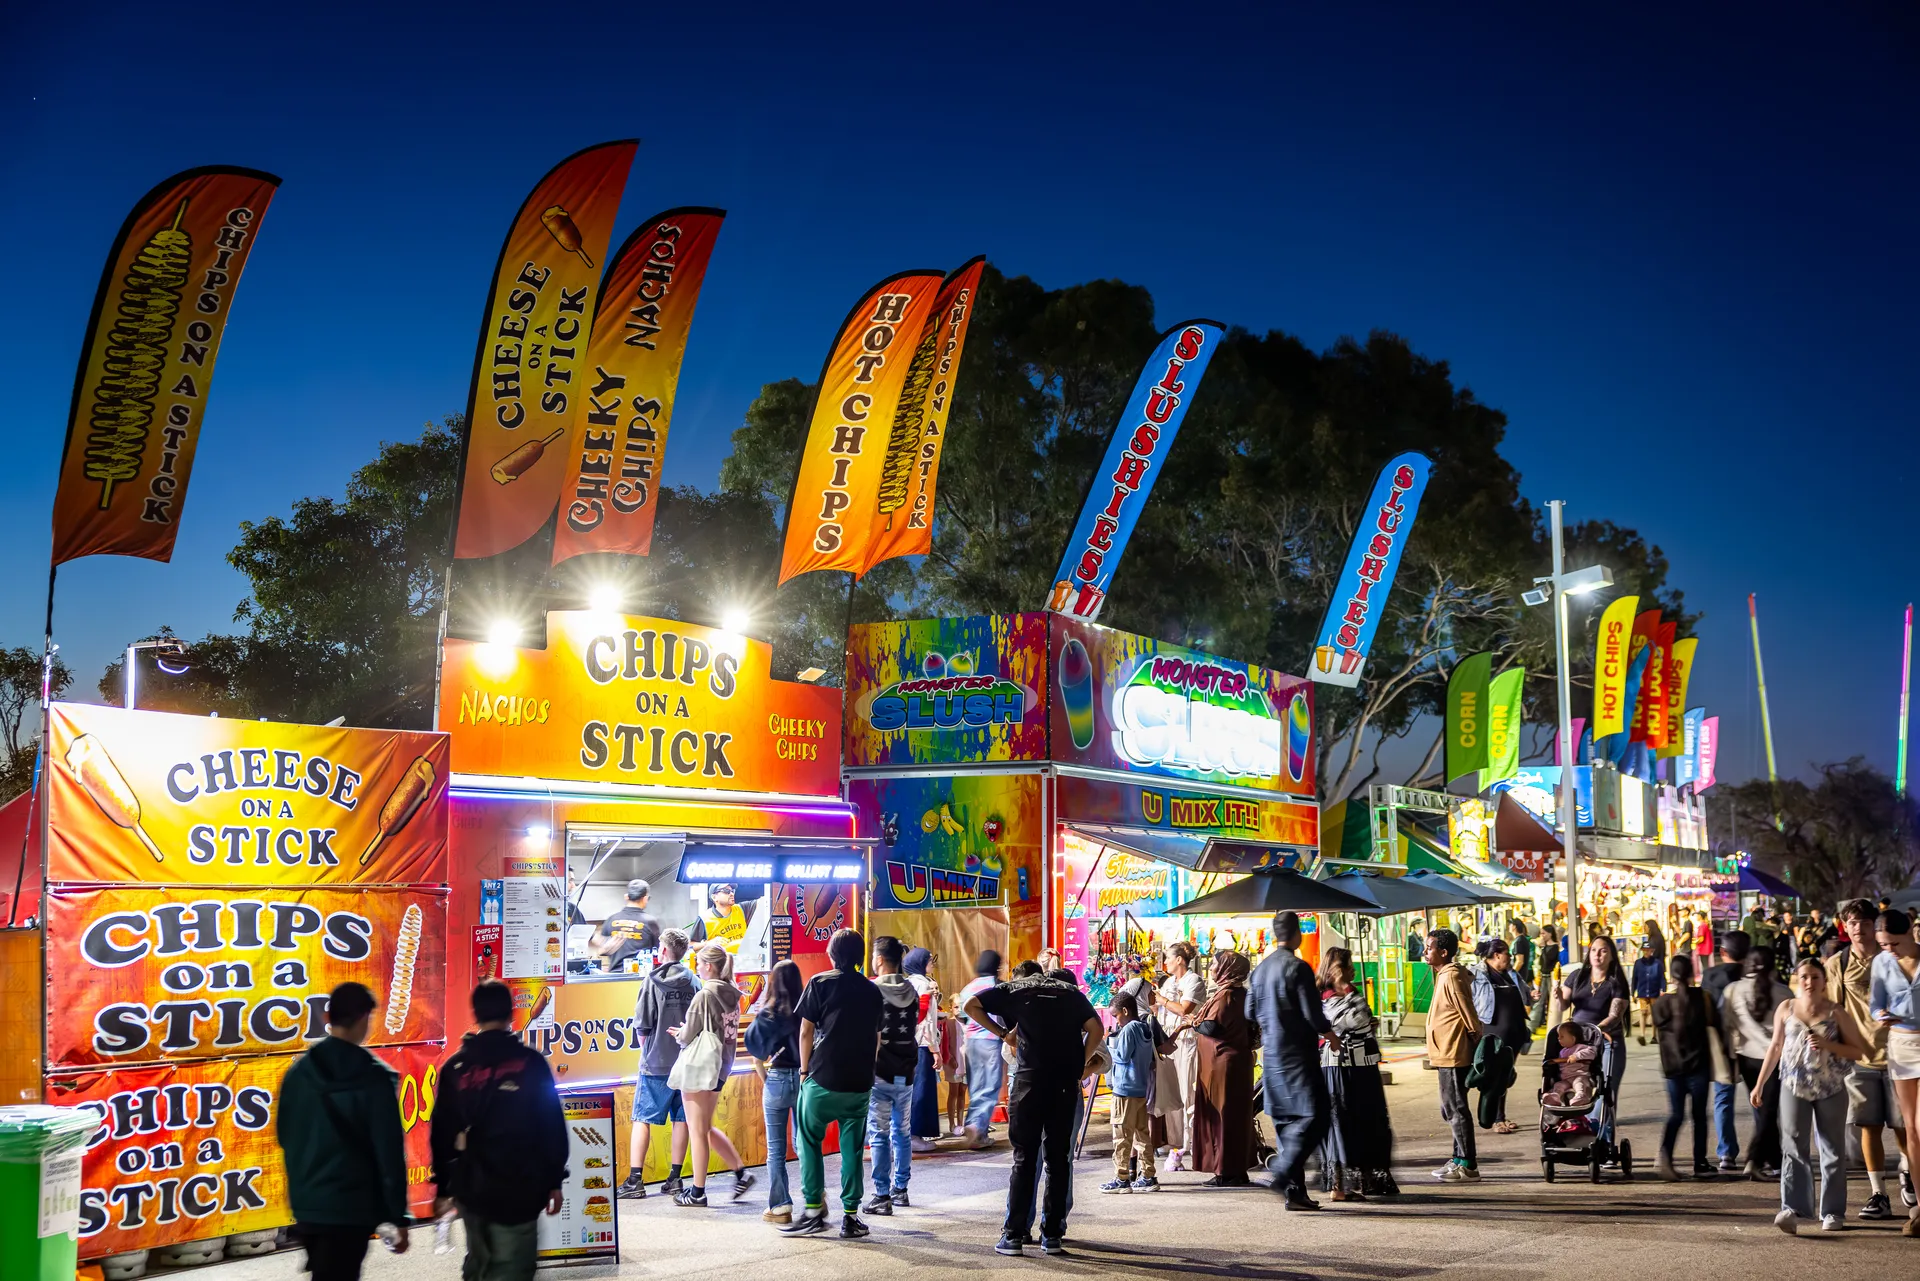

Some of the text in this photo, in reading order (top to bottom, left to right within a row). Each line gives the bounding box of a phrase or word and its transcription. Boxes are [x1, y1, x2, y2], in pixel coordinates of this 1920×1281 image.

[624, 222, 683, 352] NACHOS
[141, 207, 254, 524] CHIPS ON A STICK
[491, 260, 552, 431] CHEESE
[528, 324, 548, 370] ON A
[540, 286, 588, 414] STICK
[813, 293, 912, 554] HOT CHIPS
[907, 288, 970, 529] CHIPS ON A STICK
[566, 365, 627, 533] CHEEKY
[1075, 325, 1204, 583] SLUSHIES
[1335, 464, 1414, 648] SLUSHIES
[585, 629, 739, 700] CHIPS
[897, 675, 997, 695] MONSTER
[1151, 655, 1248, 702] MONSTER
[1602, 621, 1624, 719] HOT CHIPS
[1668, 658, 1683, 708] CHIPS
[458, 689, 551, 726] NACHOS
[636, 691, 691, 719] ON A
[768, 712, 827, 740] CHEEKY
[870, 693, 1025, 731] SLUSH
[1460, 691, 1477, 748] CORN
[580, 720, 735, 778] STICK
[1491, 704, 1508, 759] CORN
[166, 748, 363, 812] CHEESE
[241, 798, 294, 819] ON A
[1142, 789, 1261, 832] U MIX IT!!
[187, 825, 340, 867] STICK
[511, 862, 559, 871] CHIPS STICK
[1507, 857, 1538, 870] DOGS
[838, 893, 848, 909] A
[885, 860, 929, 906] U
[930, 867, 979, 904] MIX
[80, 900, 373, 969] CHIPS
[475, 928, 491, 936] CHIPS
[482, 933, 499, 941] STICK
[720, 923, 742, 935] CHIPS
[160, 959, 310, 994] on a
[584, 1019, 605, 1035] ON
[588, 1038, 600, 1053] A
[564, 1101, 602, 1110] STICK
[116, 1140, 182, 1175] on
[196, 1137, 224, 1164] a
[79, 1166, 266, 1238] STICK
